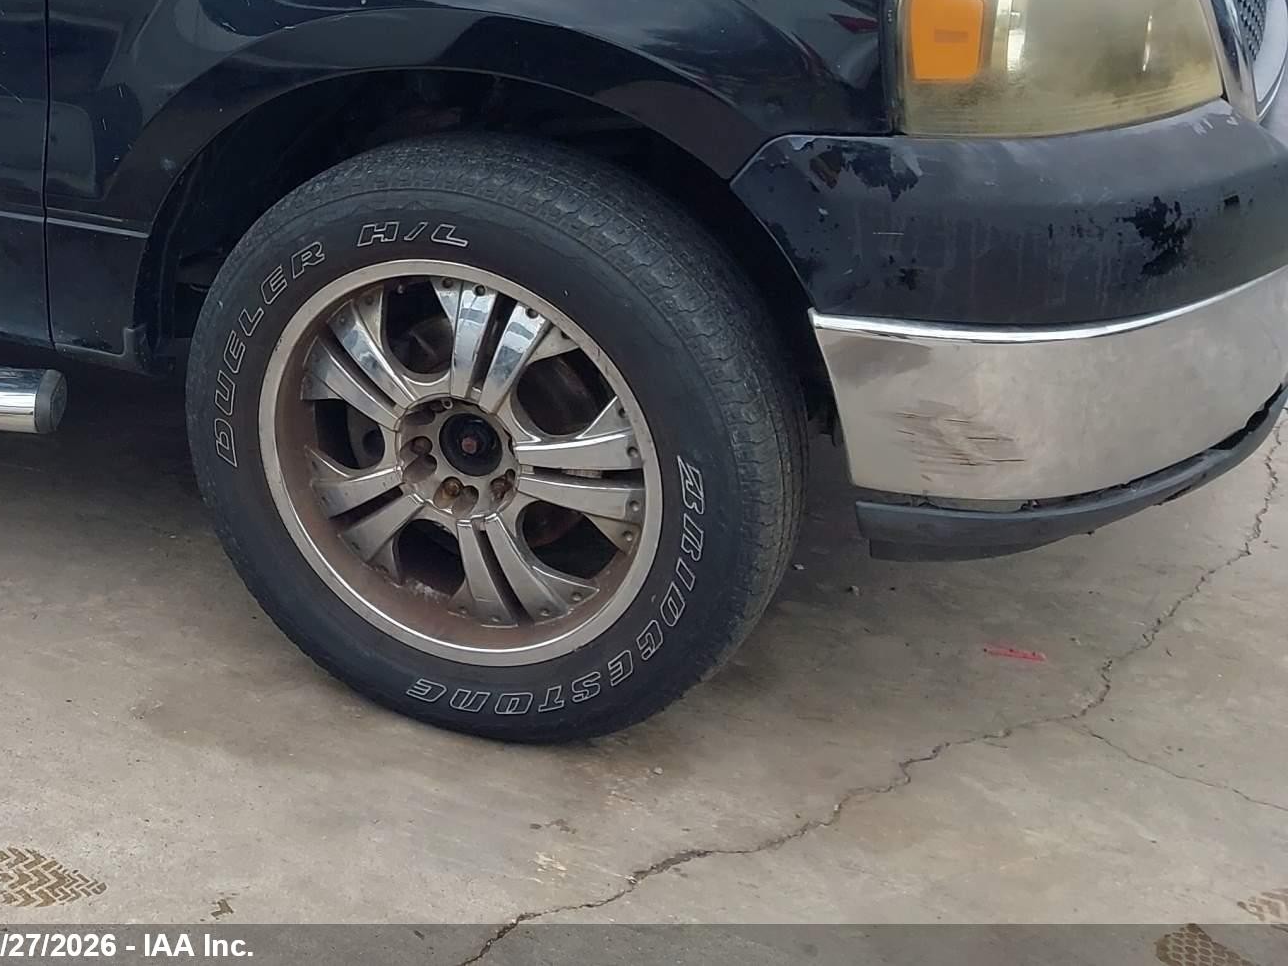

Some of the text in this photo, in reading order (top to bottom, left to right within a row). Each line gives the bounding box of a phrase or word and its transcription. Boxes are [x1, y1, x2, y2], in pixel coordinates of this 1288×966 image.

[214, 221, 469, 467] DUELER H/L
[406, 455, 705, 715] BRIDGESTONE
